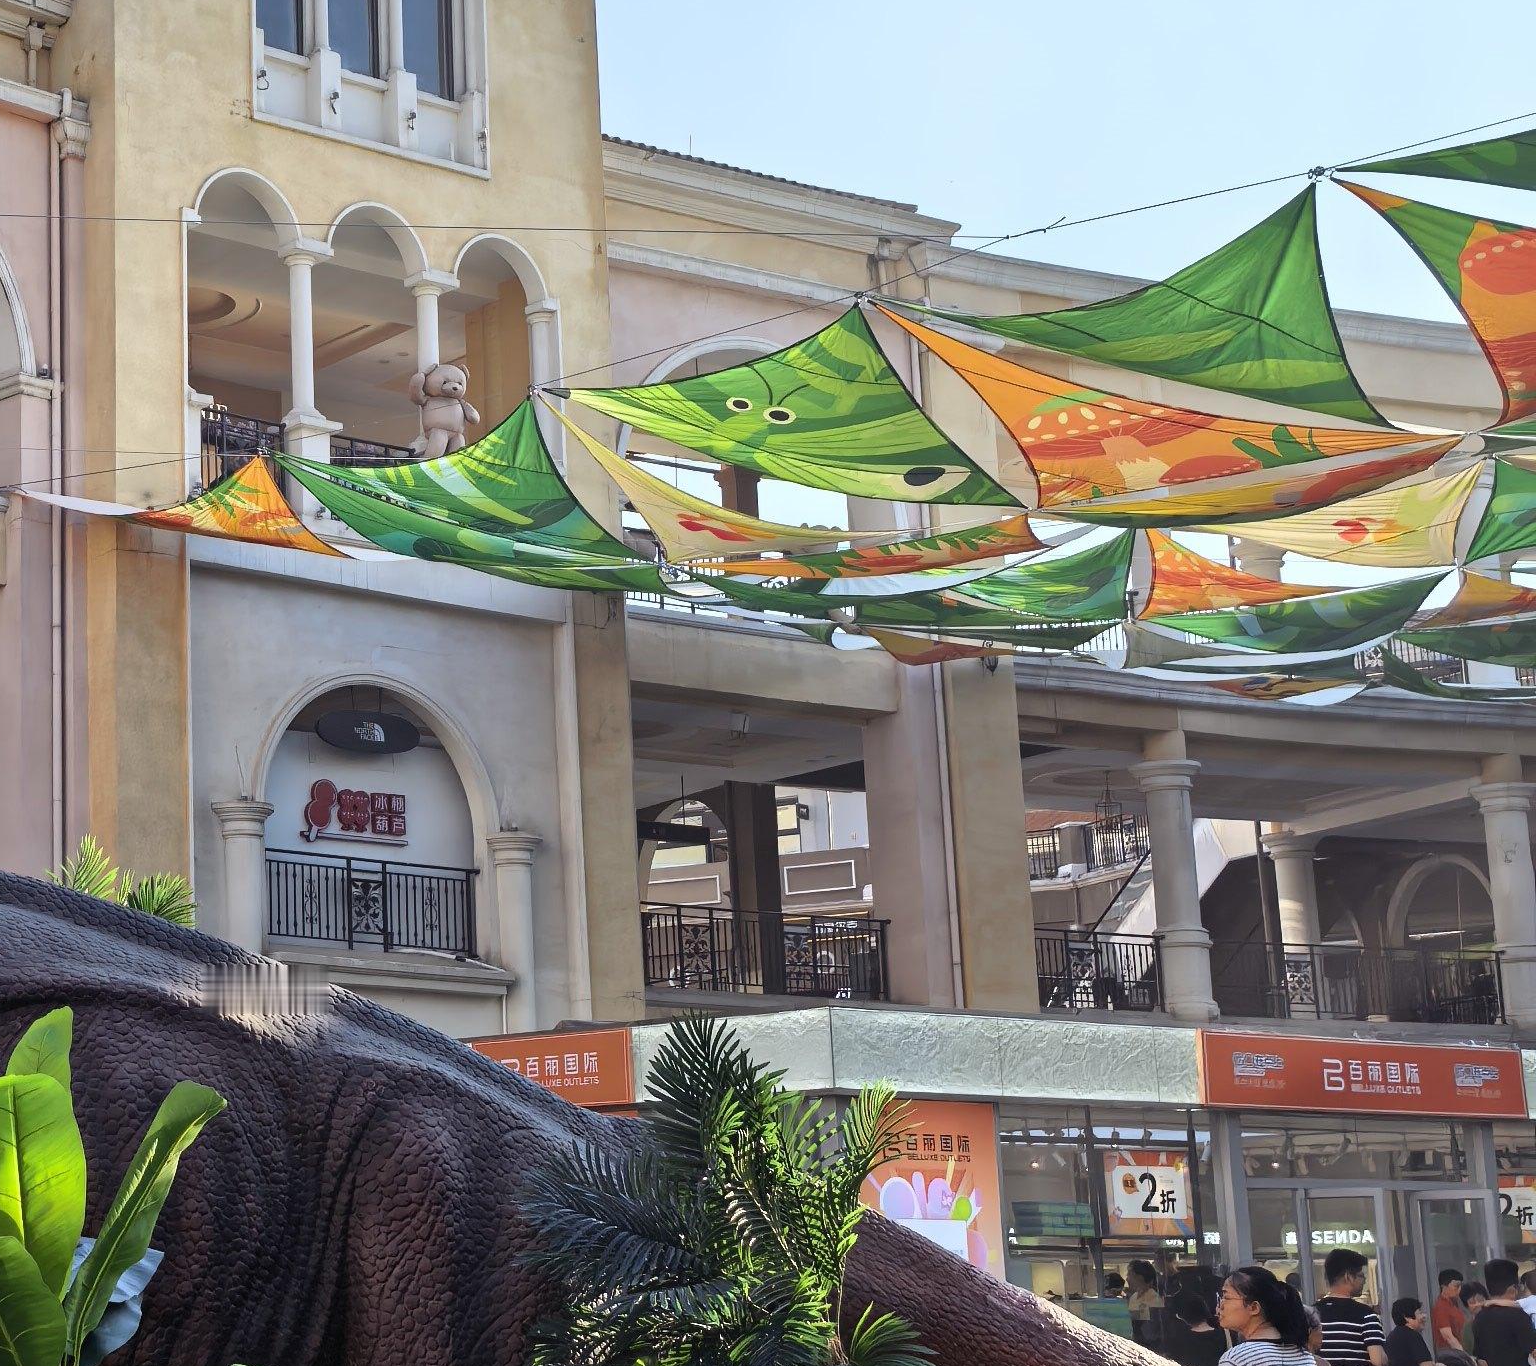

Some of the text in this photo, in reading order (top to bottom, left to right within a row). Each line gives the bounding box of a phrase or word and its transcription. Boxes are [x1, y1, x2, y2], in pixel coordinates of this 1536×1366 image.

[525, 1051, 599, 1078] 百丽国际
[1347, 1059, 1420, 1084] 百丽国际
[564, 1075, 600, 1087] OUTLETS
[905, 1133, 970, 1153] 百丽国际
[1138, 1172, 1177, 1214] 2折
[1311, 1229, 1375, 1245] SENDA
